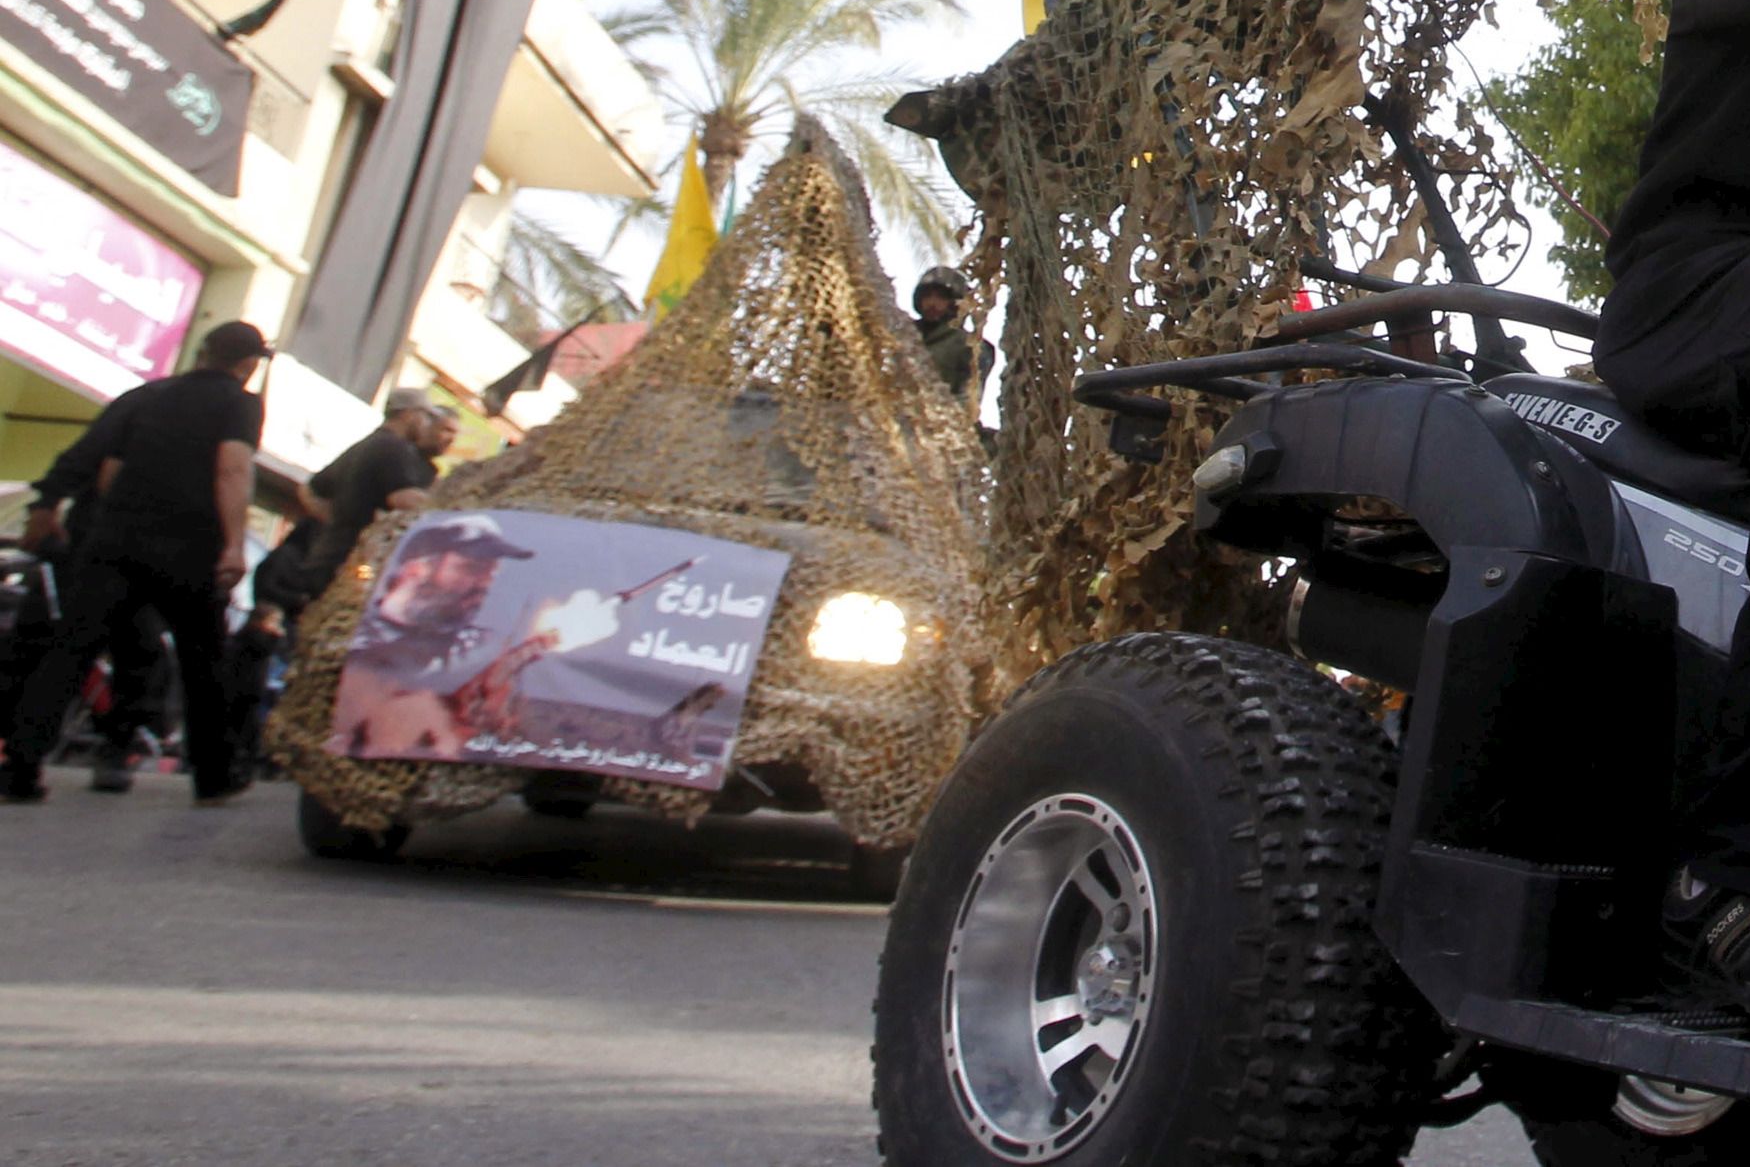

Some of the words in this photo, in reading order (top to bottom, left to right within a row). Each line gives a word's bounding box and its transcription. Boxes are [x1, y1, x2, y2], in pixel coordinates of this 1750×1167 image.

[1663, 528, 1745, 577] 250
[656, 576, 767, 619] صاروخ
[627, 628, 750, 675] العماد
[1707, 903, 1744, 944] DOCKERS
